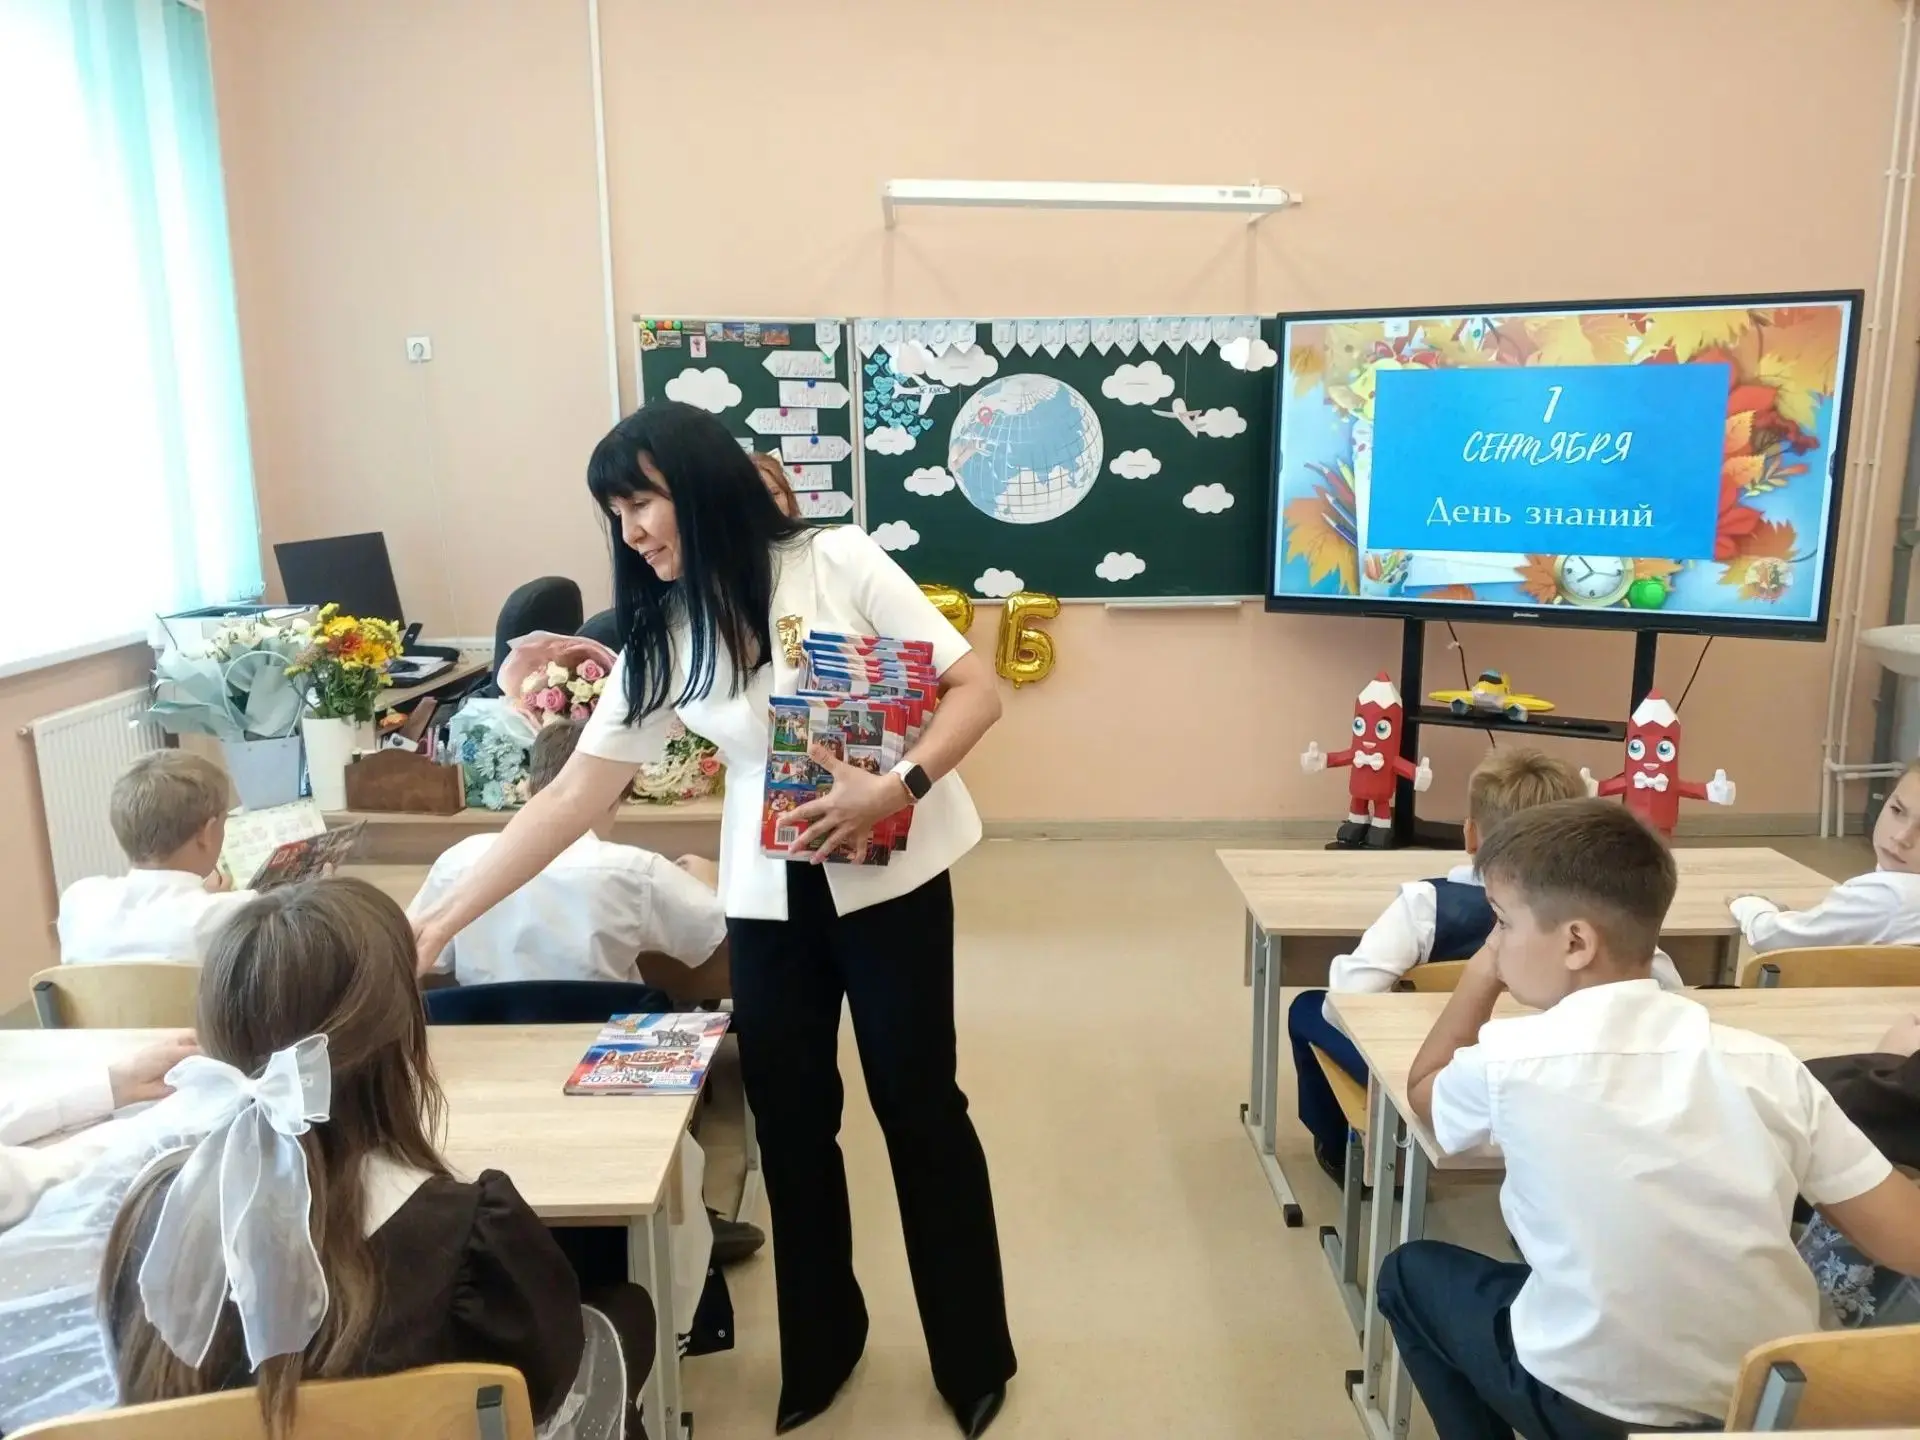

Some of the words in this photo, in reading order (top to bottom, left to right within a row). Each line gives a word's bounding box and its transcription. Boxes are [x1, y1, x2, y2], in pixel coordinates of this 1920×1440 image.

[1542, 384, 1564, 424] 1
[1462, 430, 1634, 467] СЕНТЯБРЯ
[1426, 496, 1512, 527] День
[1525, 503, 1655, 528] знаний
